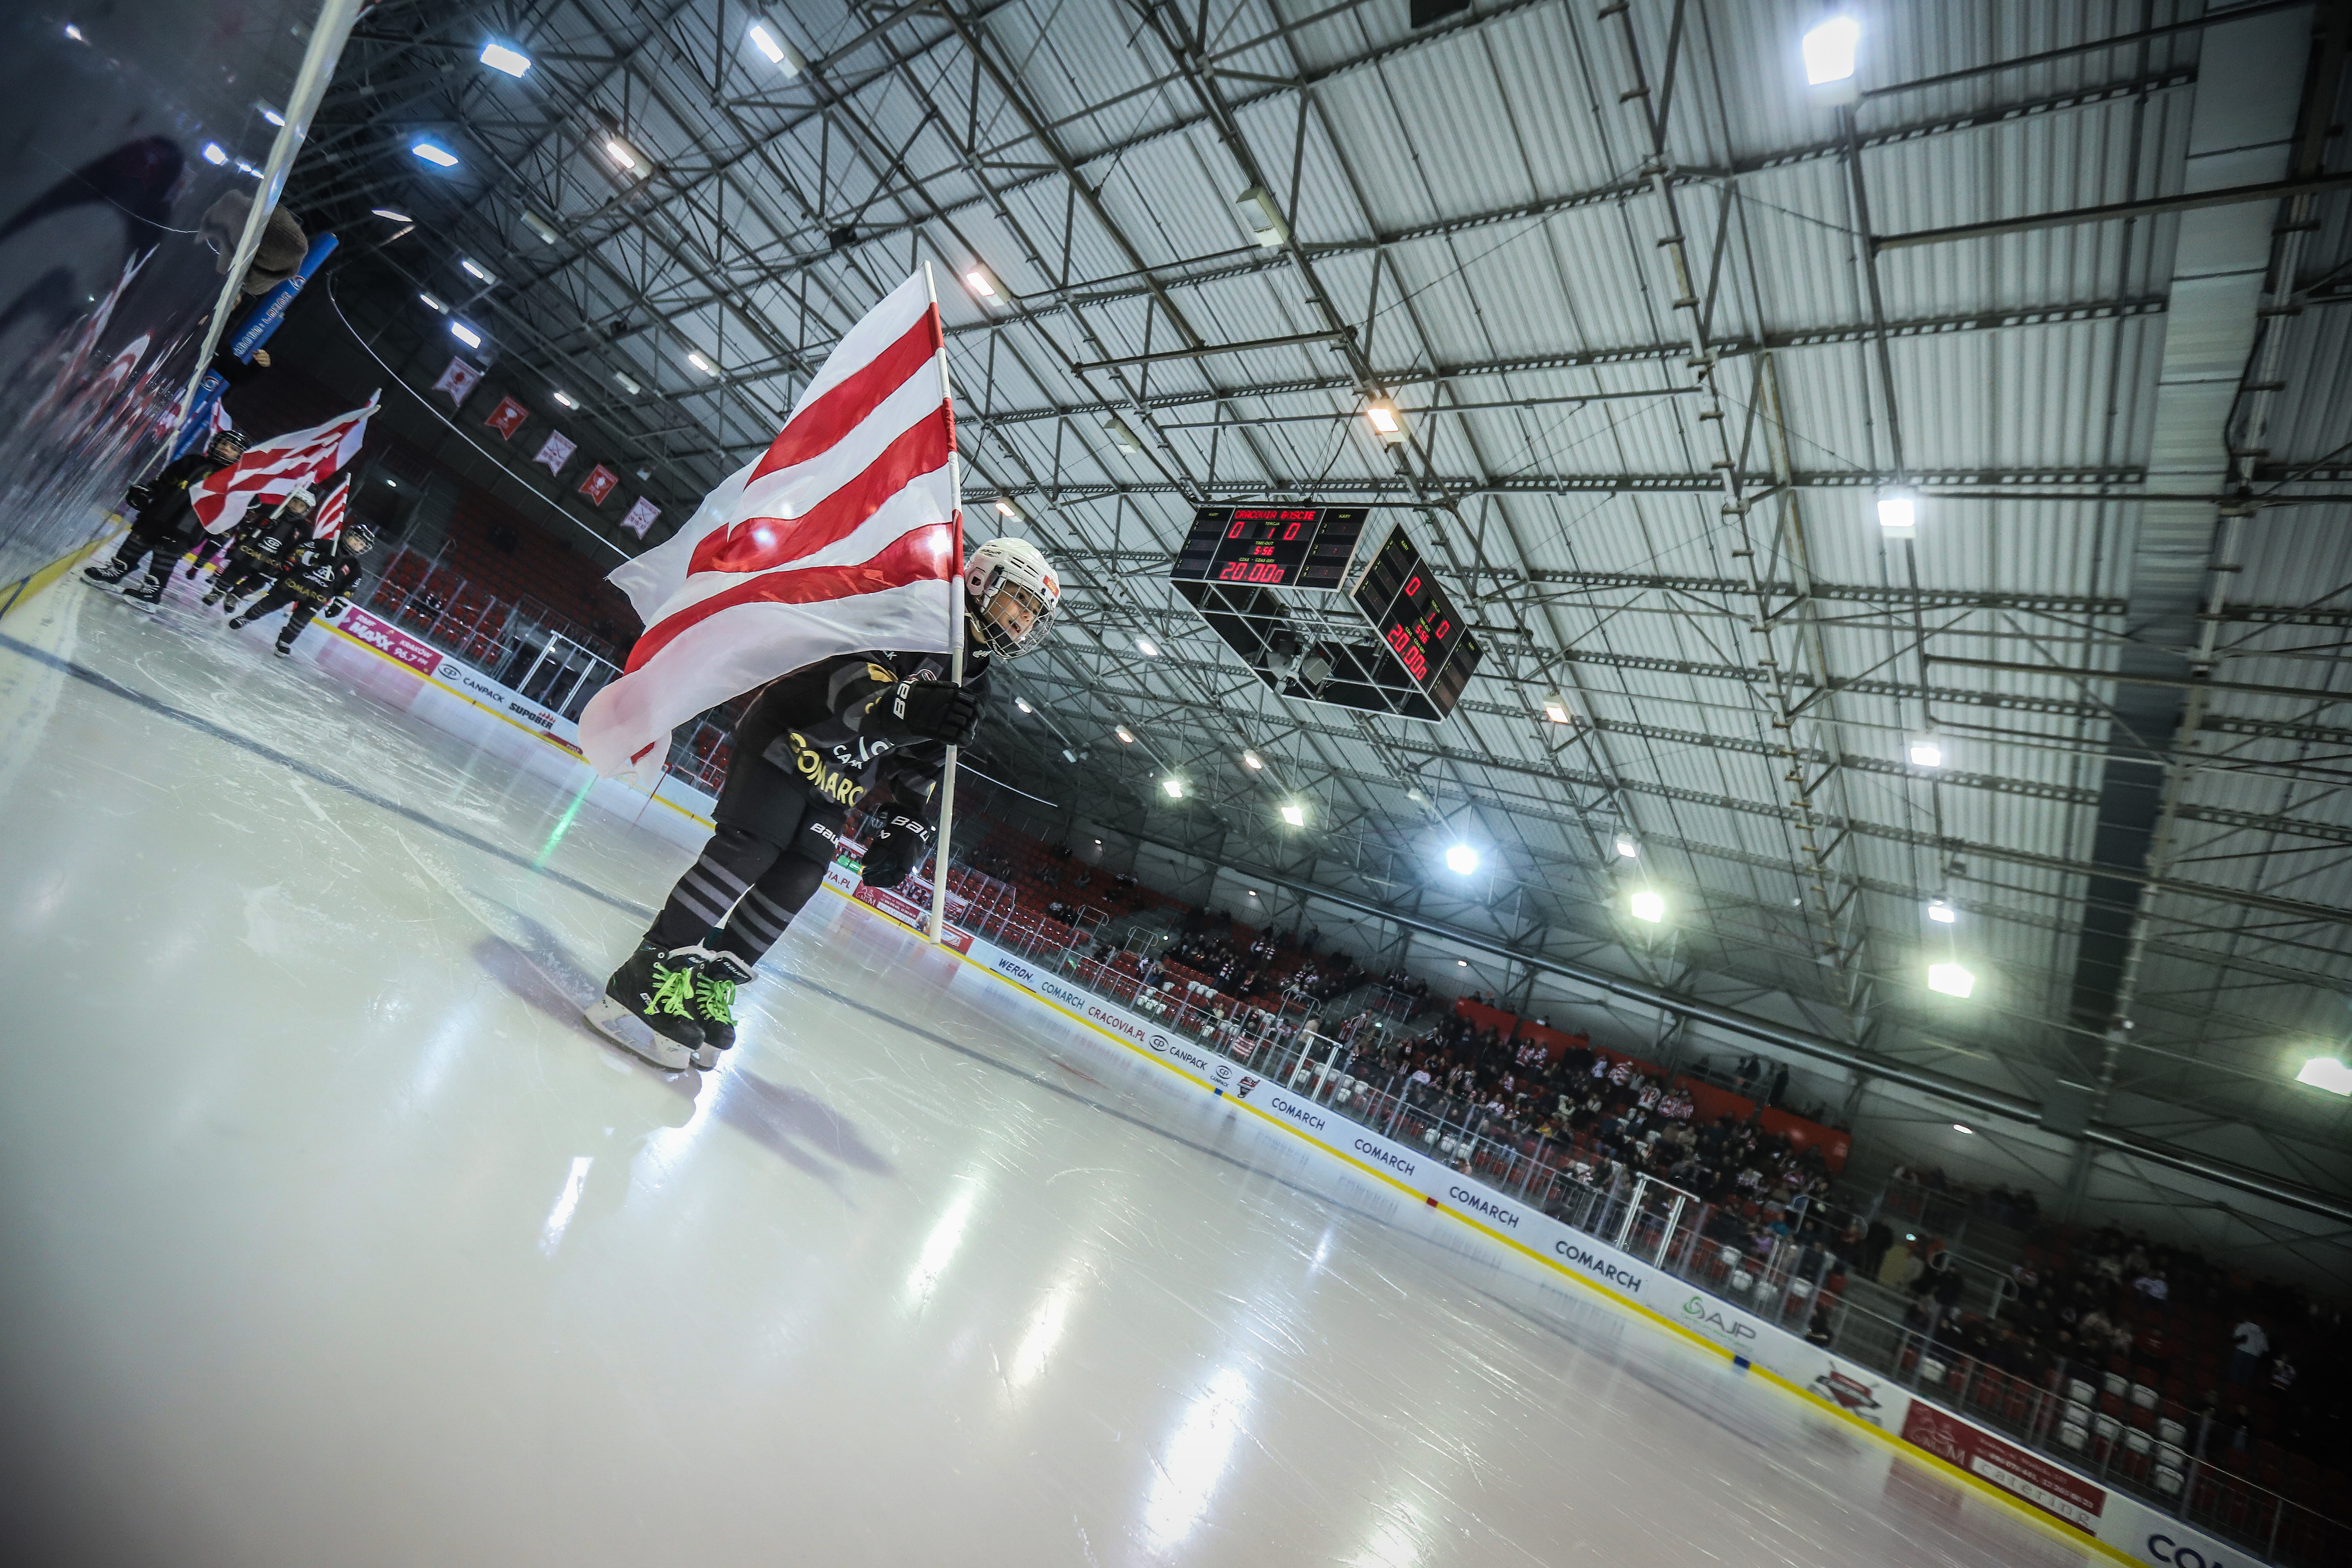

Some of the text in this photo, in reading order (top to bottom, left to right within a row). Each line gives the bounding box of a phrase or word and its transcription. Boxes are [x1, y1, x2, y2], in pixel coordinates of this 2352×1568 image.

[1234, 510, 1277, 519] CRACOVIA
[1228, 522, 1245, 539] 0
[1268, 528, 1275, 539] 1
[1283, 523, 1301, 540] 0
[1401, 540, 1409, 551] KARY
[1405, 577, 1421, 596] 0
[1432, 600, 1441, 614] TERCJA
[356, 614, 377, 626] RMF
[1419, 617, 1431, 632] TIME-OUT
[1427, 612, 1436, 622] 1
[1435, 620, 1450, 639] 0
[394, 647, 417, 662] 96.7
[463, 678, 505, 703] CANPACK
[880, 905, 913, 924] catering
[999, 958, 1034, 981] WERON
[1041, 982, 1086, 1010] COMARCH
[1088, 1007, 1145, 1042] CRACOVIA.PL
[1170, 1047, 1208, 1071] CANPACK
[1210, 1075, 1229, 1088] CANPACK
[1272, 1098, 1325, 1131] COMARCH
[1355, 1139, 1415, 1176] COMARCH
[1450, 1186, 1519, 1228] COMARCH
[1555, 1241, 1642, 1292] COMARCH
[1707, 1312, 1757, 1340] AJP
[1982, 1464, 2090, 1527] catering
